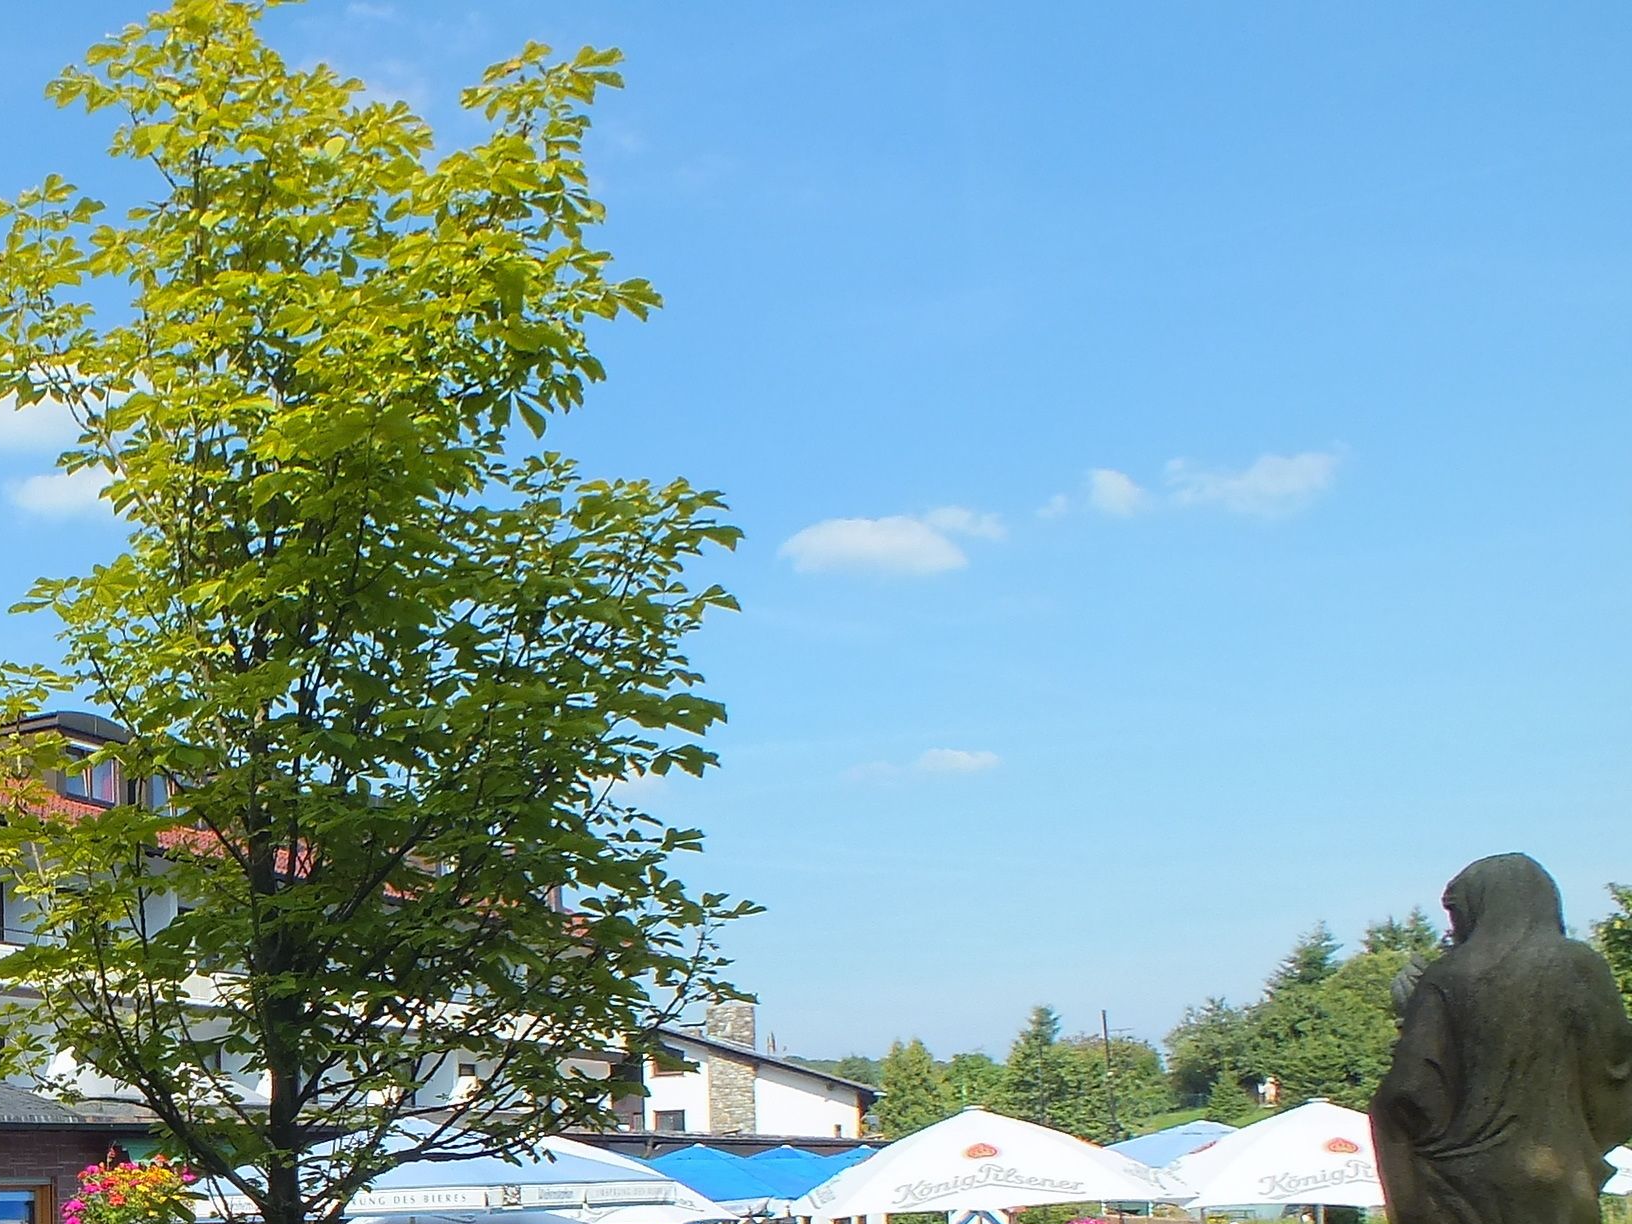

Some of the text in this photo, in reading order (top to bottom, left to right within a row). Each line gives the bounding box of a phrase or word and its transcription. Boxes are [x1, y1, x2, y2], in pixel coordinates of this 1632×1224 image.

[892, 1163, 1086, 1204] König Pilsener
[1258, 1169, 1345, 1196] König
[393, 1194, 416, 1204] DES
[423, 1192, 467, 1203] BIERES
